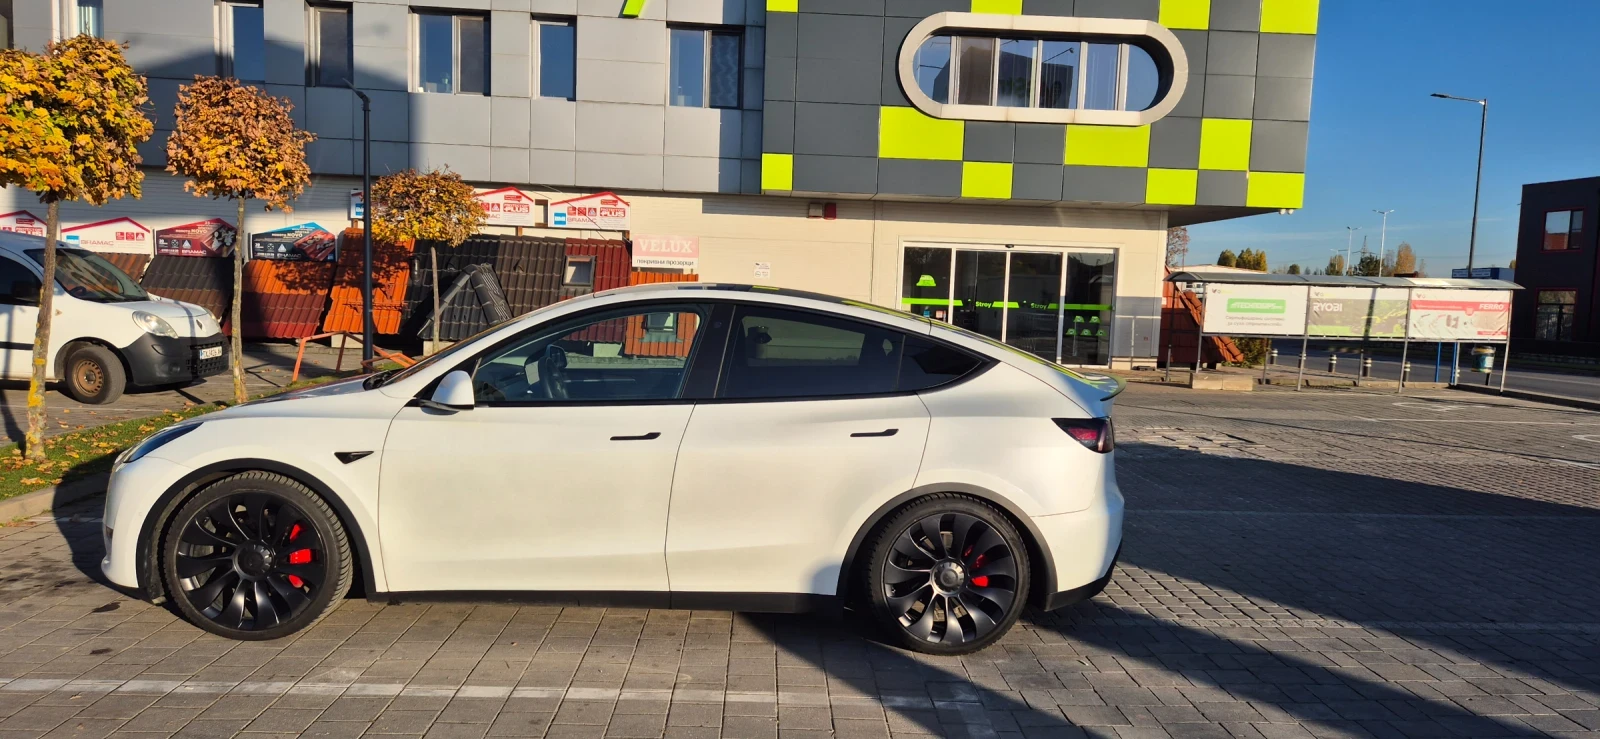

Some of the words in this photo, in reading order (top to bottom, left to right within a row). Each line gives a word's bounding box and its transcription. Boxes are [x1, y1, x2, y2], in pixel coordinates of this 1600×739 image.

[80, 239, 114, 247] BRAMAC
[638, 239, 693, 253] VELUX
[1030, 302, 1048, 310] Stroy
[1312, 302, 1342, 312] RYOBI
